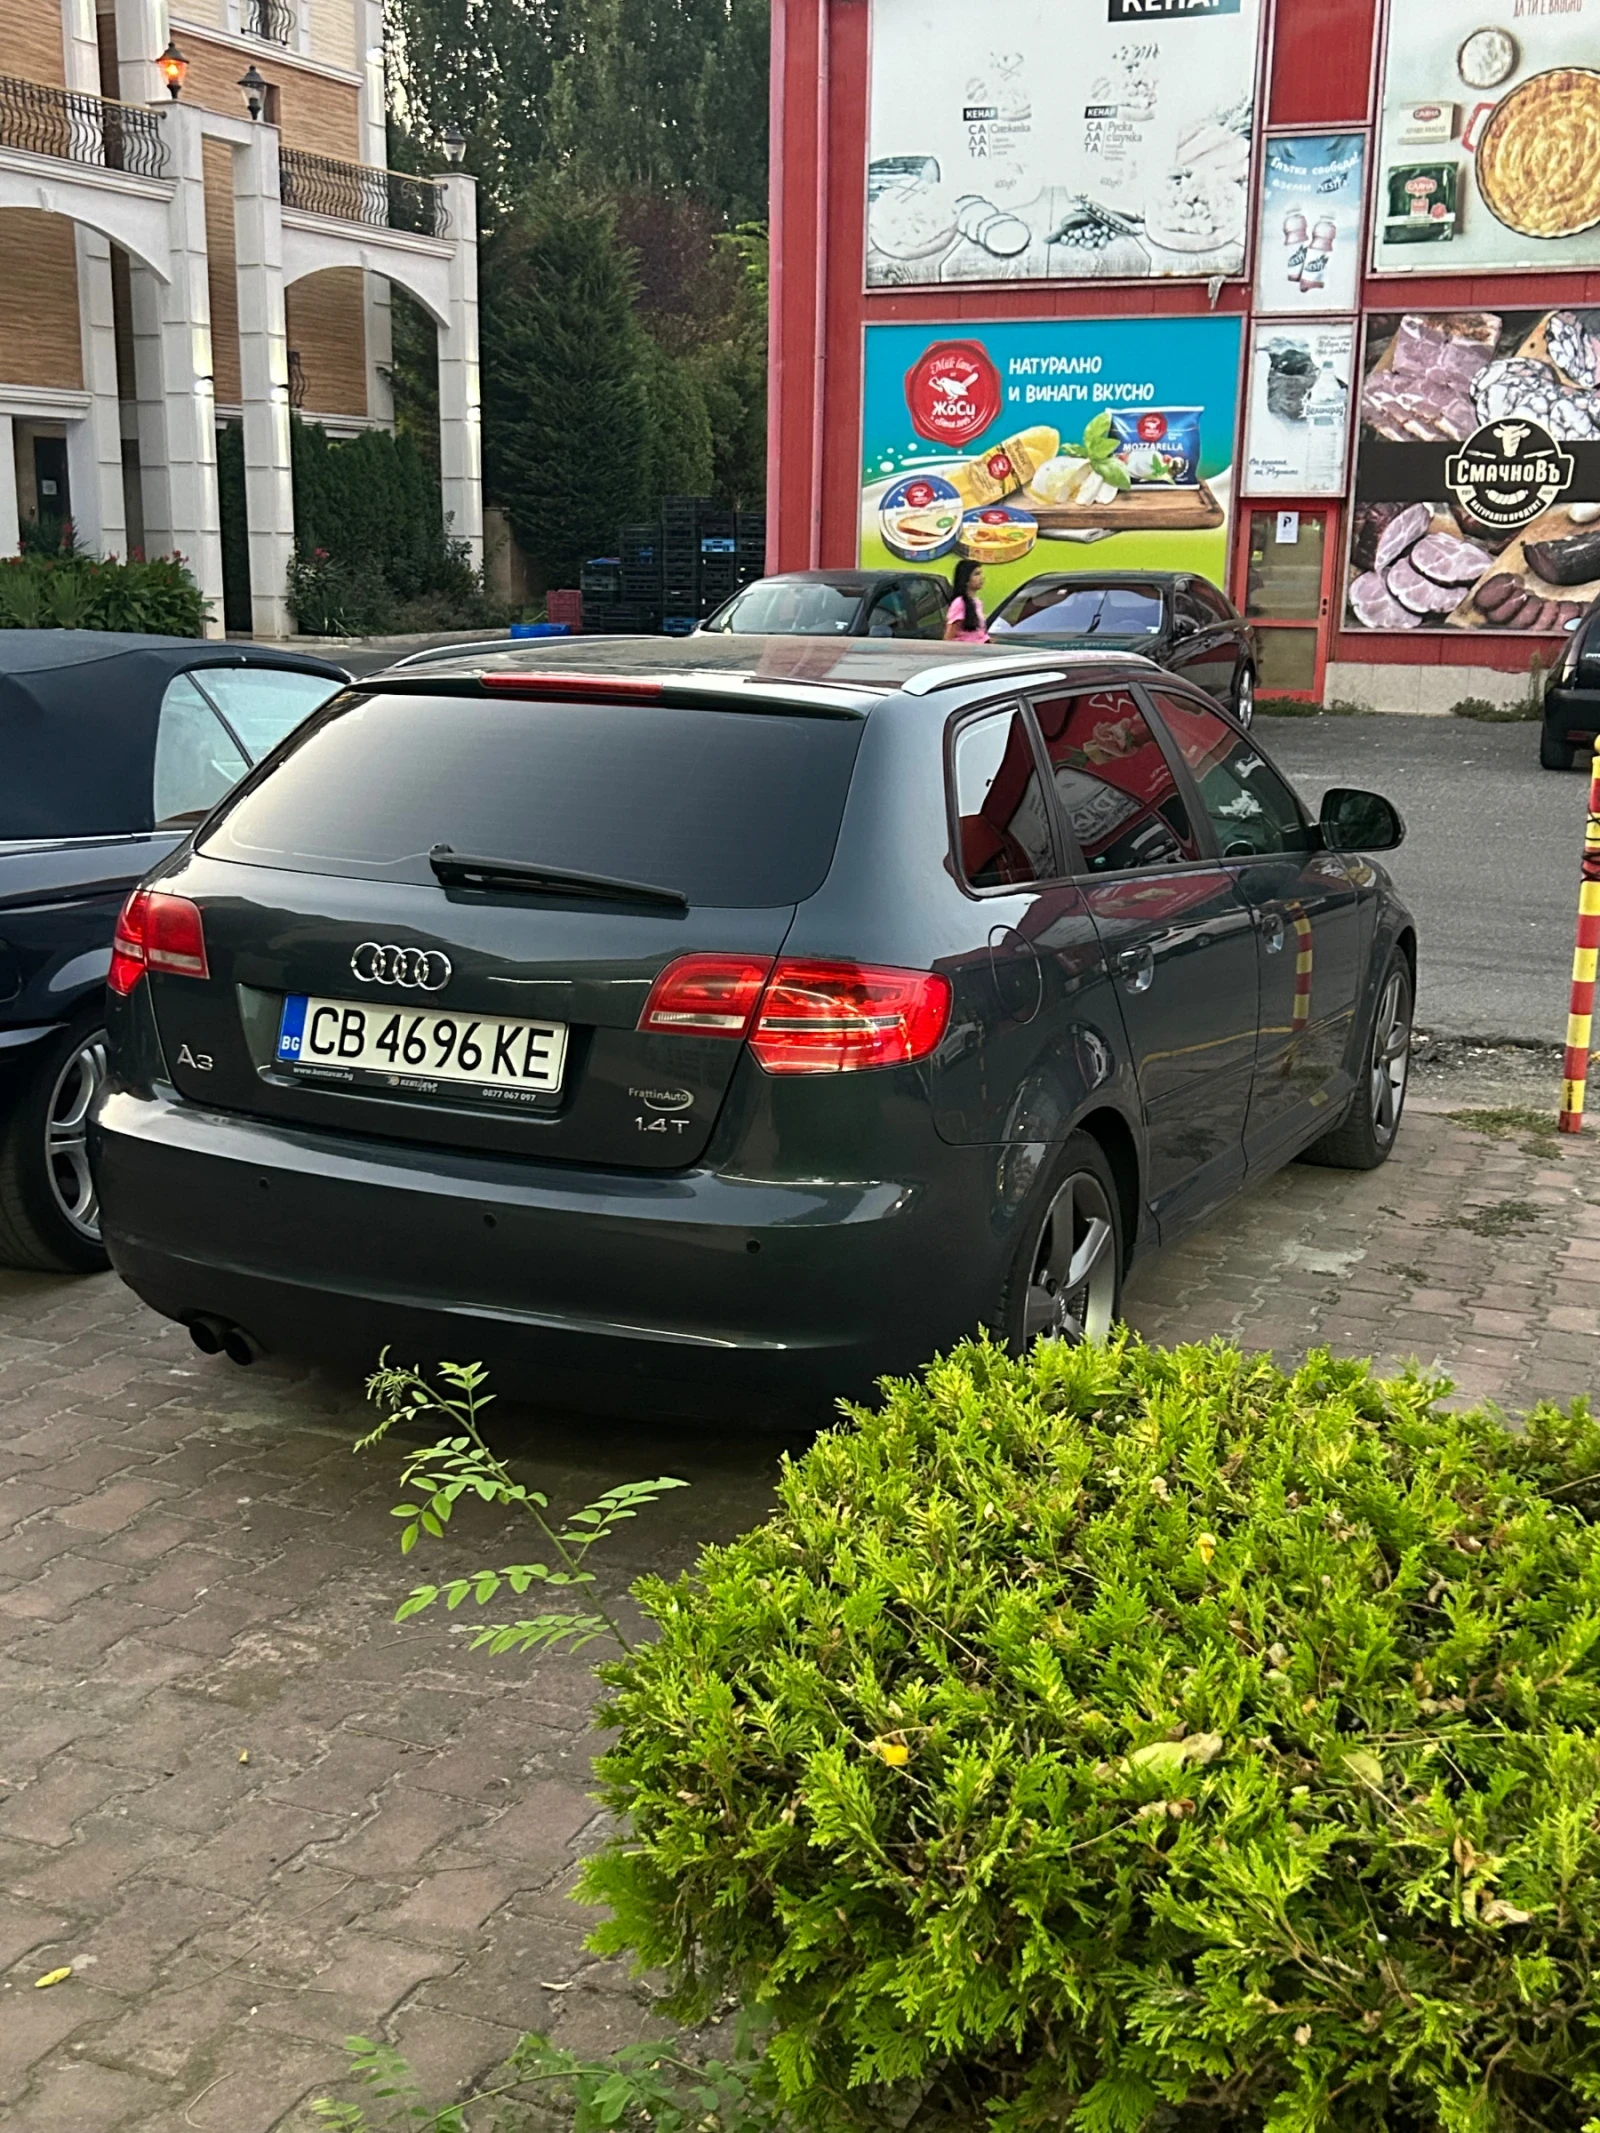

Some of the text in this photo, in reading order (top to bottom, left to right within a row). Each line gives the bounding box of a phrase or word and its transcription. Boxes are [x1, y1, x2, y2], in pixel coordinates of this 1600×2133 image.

[1009, 356, 1102, 375] НАТУРАЛНО
[1008, 383, 1155, 403] И ВИНАГИ ВКУСНО
[1122, 442, 1184, 452] MOZZARELLA
[281, 1035, 300, 1051] BG
[310, 1006, 555, 1080] CB 4696 KE
[176, 1044, 213, 1071] A3
[482, 1088, 503, 1098] 0877
[628, 1087, 688, 1102] FrattinAuto
[635, 1116, 690, 1134] 1.4 T
